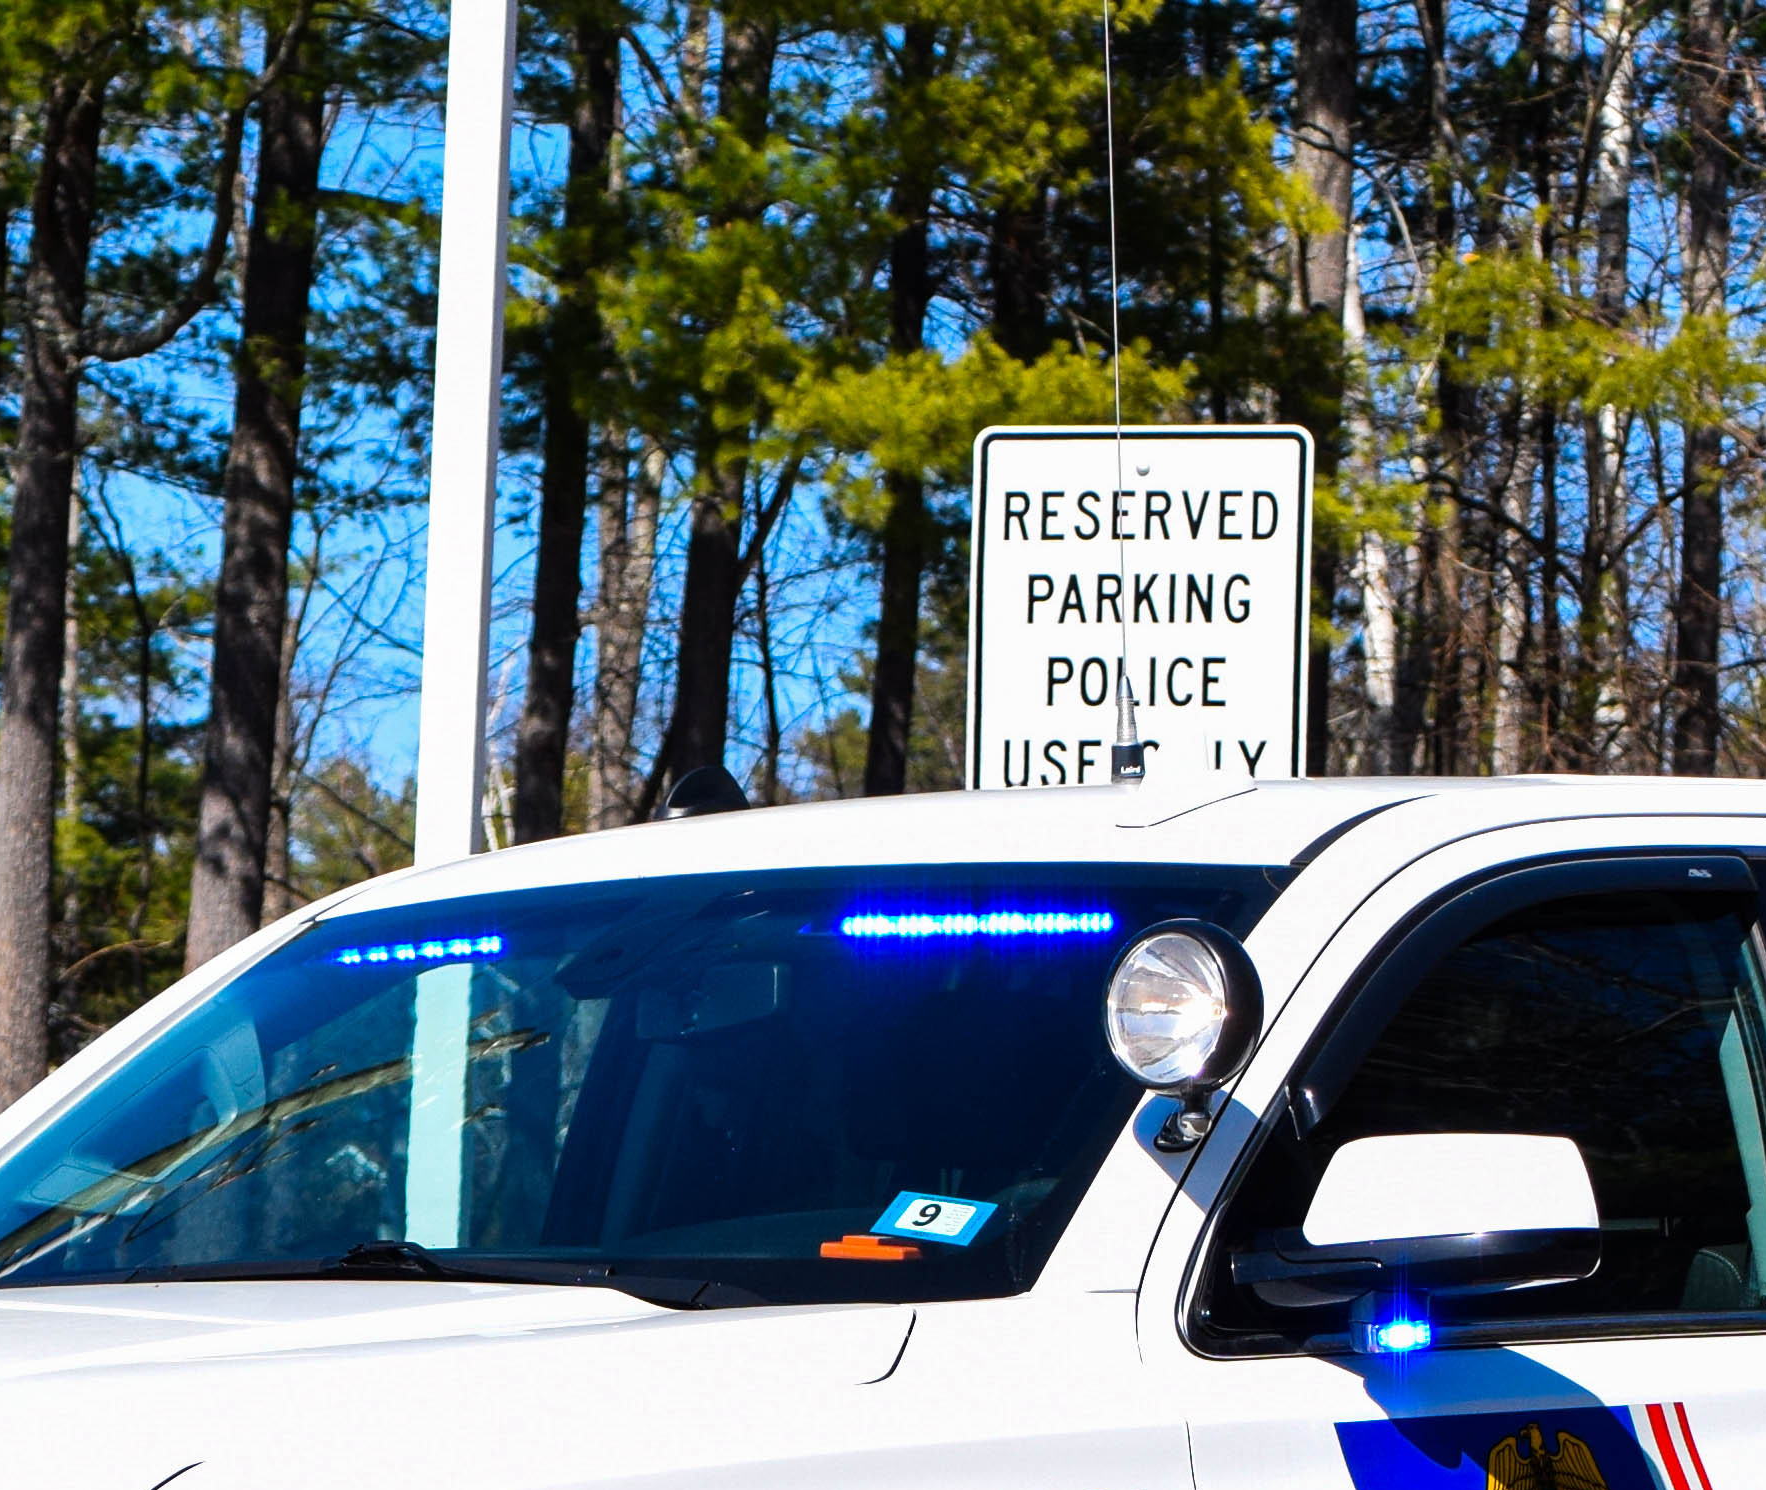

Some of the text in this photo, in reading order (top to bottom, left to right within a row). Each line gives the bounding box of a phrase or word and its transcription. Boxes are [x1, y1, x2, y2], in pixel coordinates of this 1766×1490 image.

[1003, 490, 1279, 541] RESERVED
[1026, 573, 1252, 624] PARKING
[911, 1203, 943, 1227] 9
